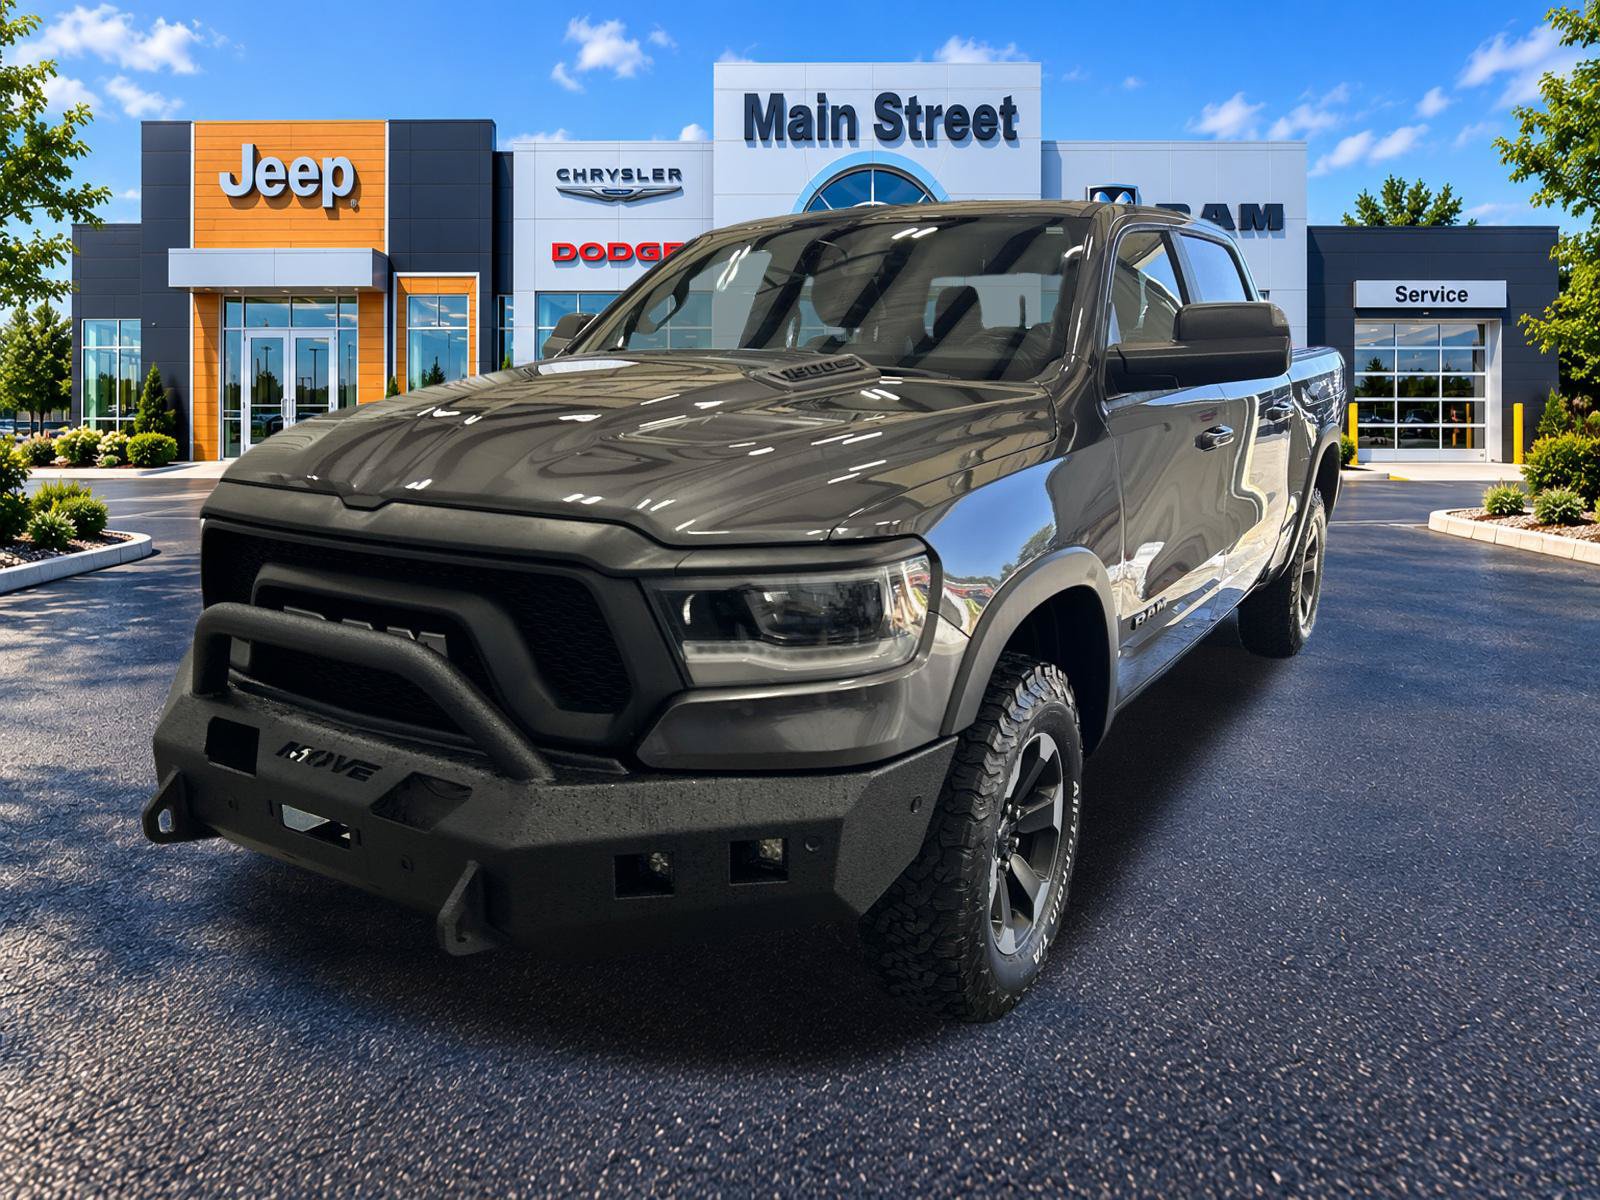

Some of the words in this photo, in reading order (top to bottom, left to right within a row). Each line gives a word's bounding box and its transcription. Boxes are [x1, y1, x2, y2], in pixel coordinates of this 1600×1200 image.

[744, 93, 857, 141] Main
[873, 92, 1018, 141] Street
[218, 144, 356, 208] Jeep
[556, 168, 682, 181] CHRYSLER
[1395, 285, 1469, 303] Service
[1130, 596, 1168, 630] RAM
[275, 741, 382, 782] MOVE
[1050, 780, 1080, 925] All-Terrain
